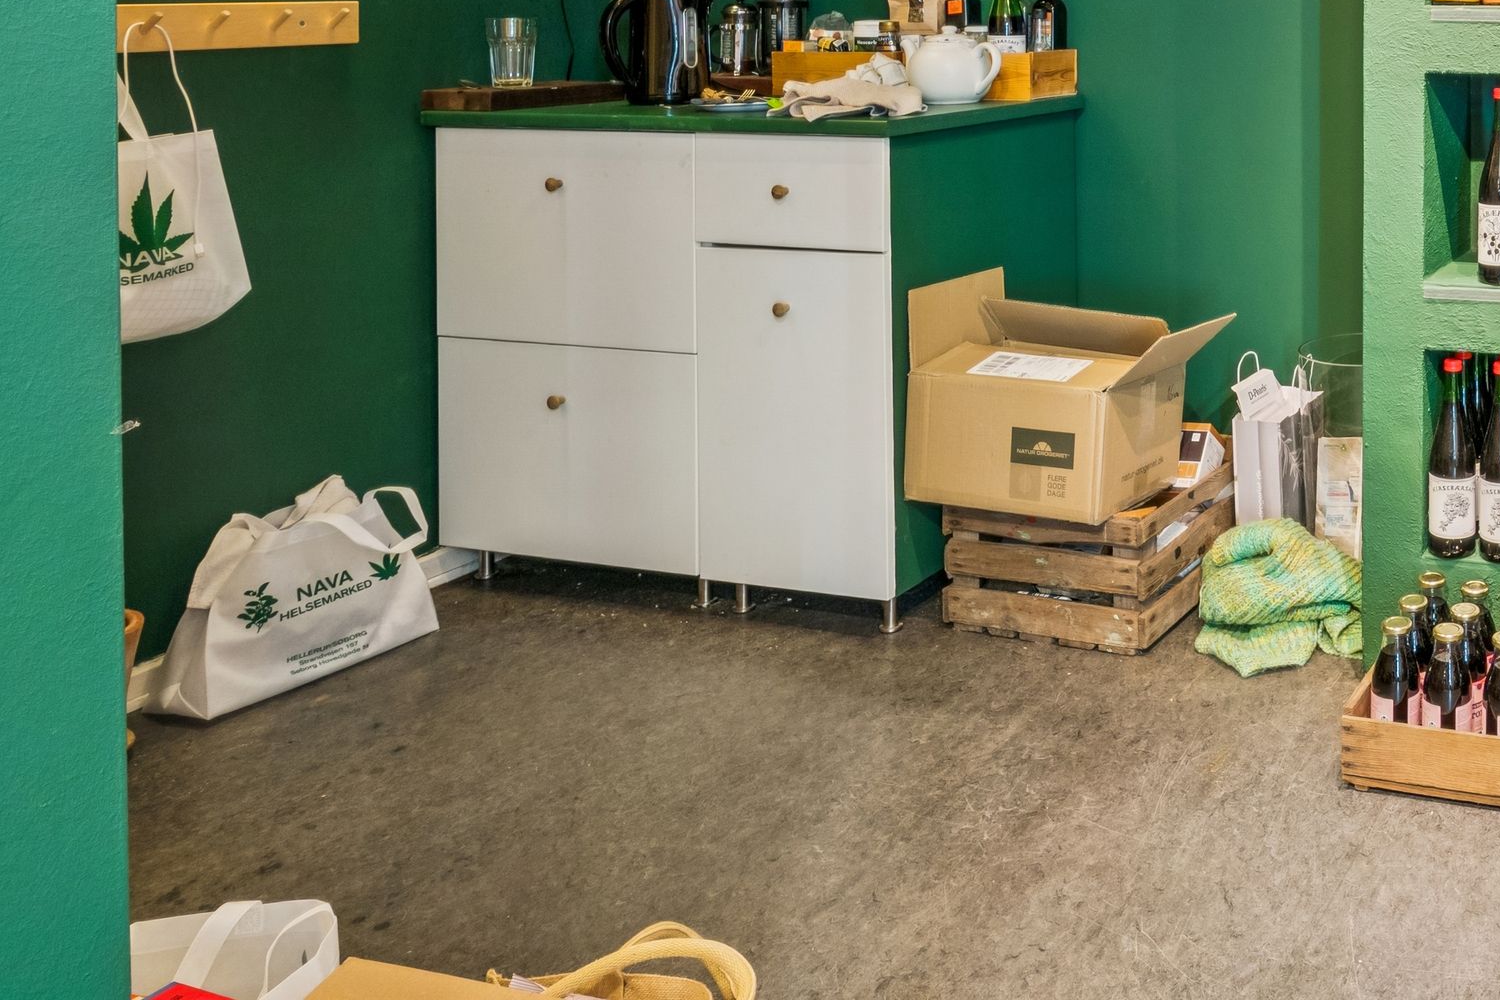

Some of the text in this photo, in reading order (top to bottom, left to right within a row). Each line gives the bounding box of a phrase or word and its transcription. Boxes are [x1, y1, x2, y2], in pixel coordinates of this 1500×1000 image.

[120, 261, 194, 286] SEMARKED
[1047, 474, 1068, 483] FLERE
[1047, 482, 1067, 491] GODE
[1046, 490, 1066, 498] DAGE
[296, 569, 354, 602] NAVA
[279, 579, 373, 622] HELSEMARKED
